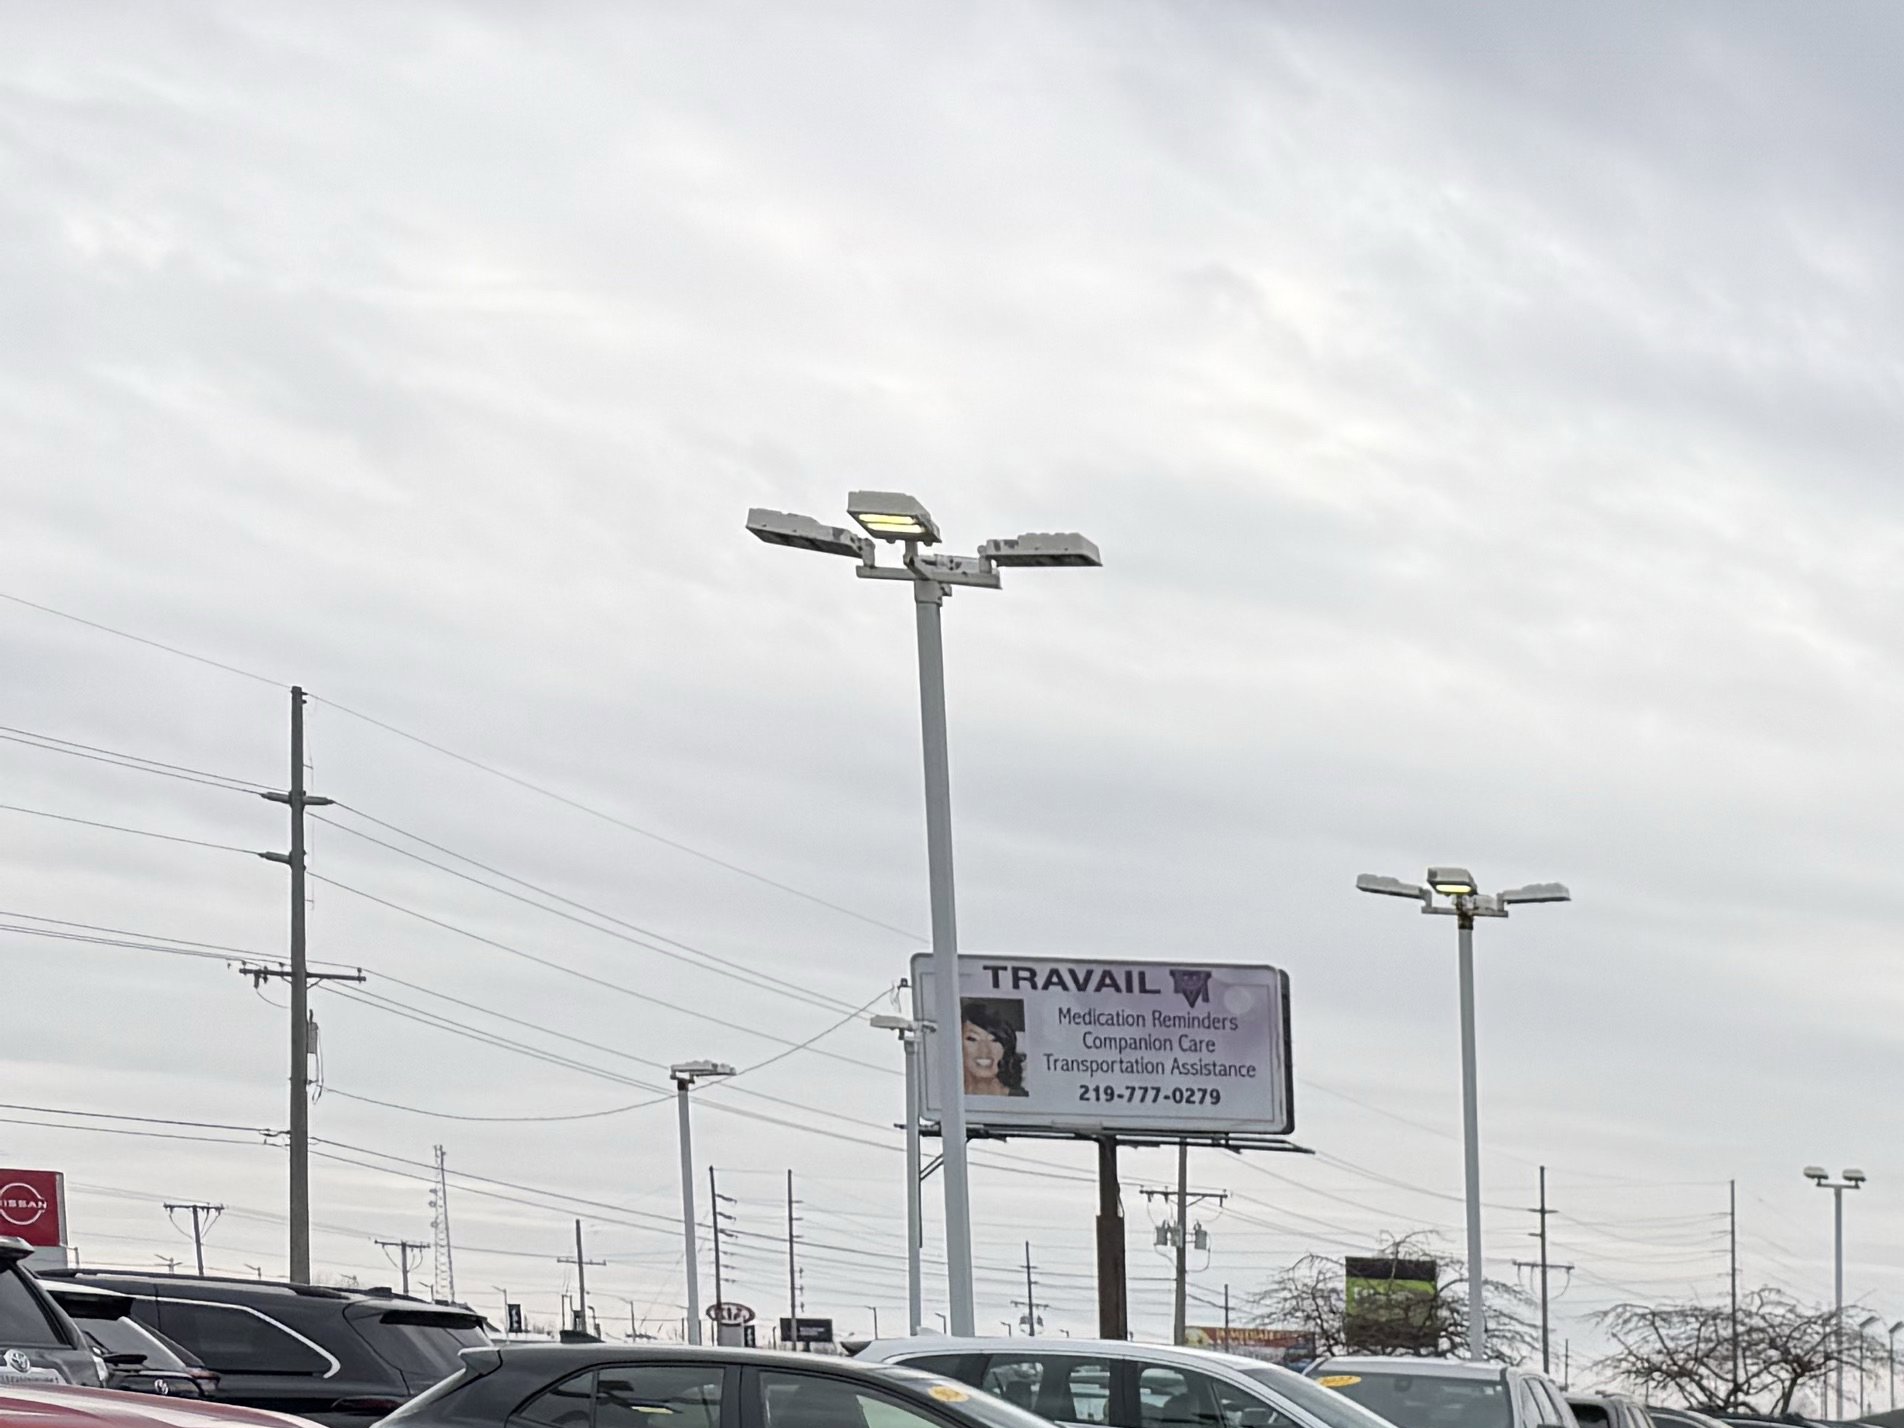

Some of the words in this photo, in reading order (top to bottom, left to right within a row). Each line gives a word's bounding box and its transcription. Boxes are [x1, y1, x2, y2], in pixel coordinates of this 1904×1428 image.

[982, 965, 1162, 995] TRAVAIL
[1058, 1007, 1147, 1028] Medication
[1152, 1010, 1239, 1031] Reminders
[1082, 1031, 1174, 1055] Companion
[1178, 1034, 1217, 1053] Care
[1043, 1053, 1166, 1079] Transportation
[1170, 1057, 1257, 1078] Assistance
[1078, 1084, 1222, 1106] 219-777-0279
[0, 1199, 48, 1210] ISSAN
